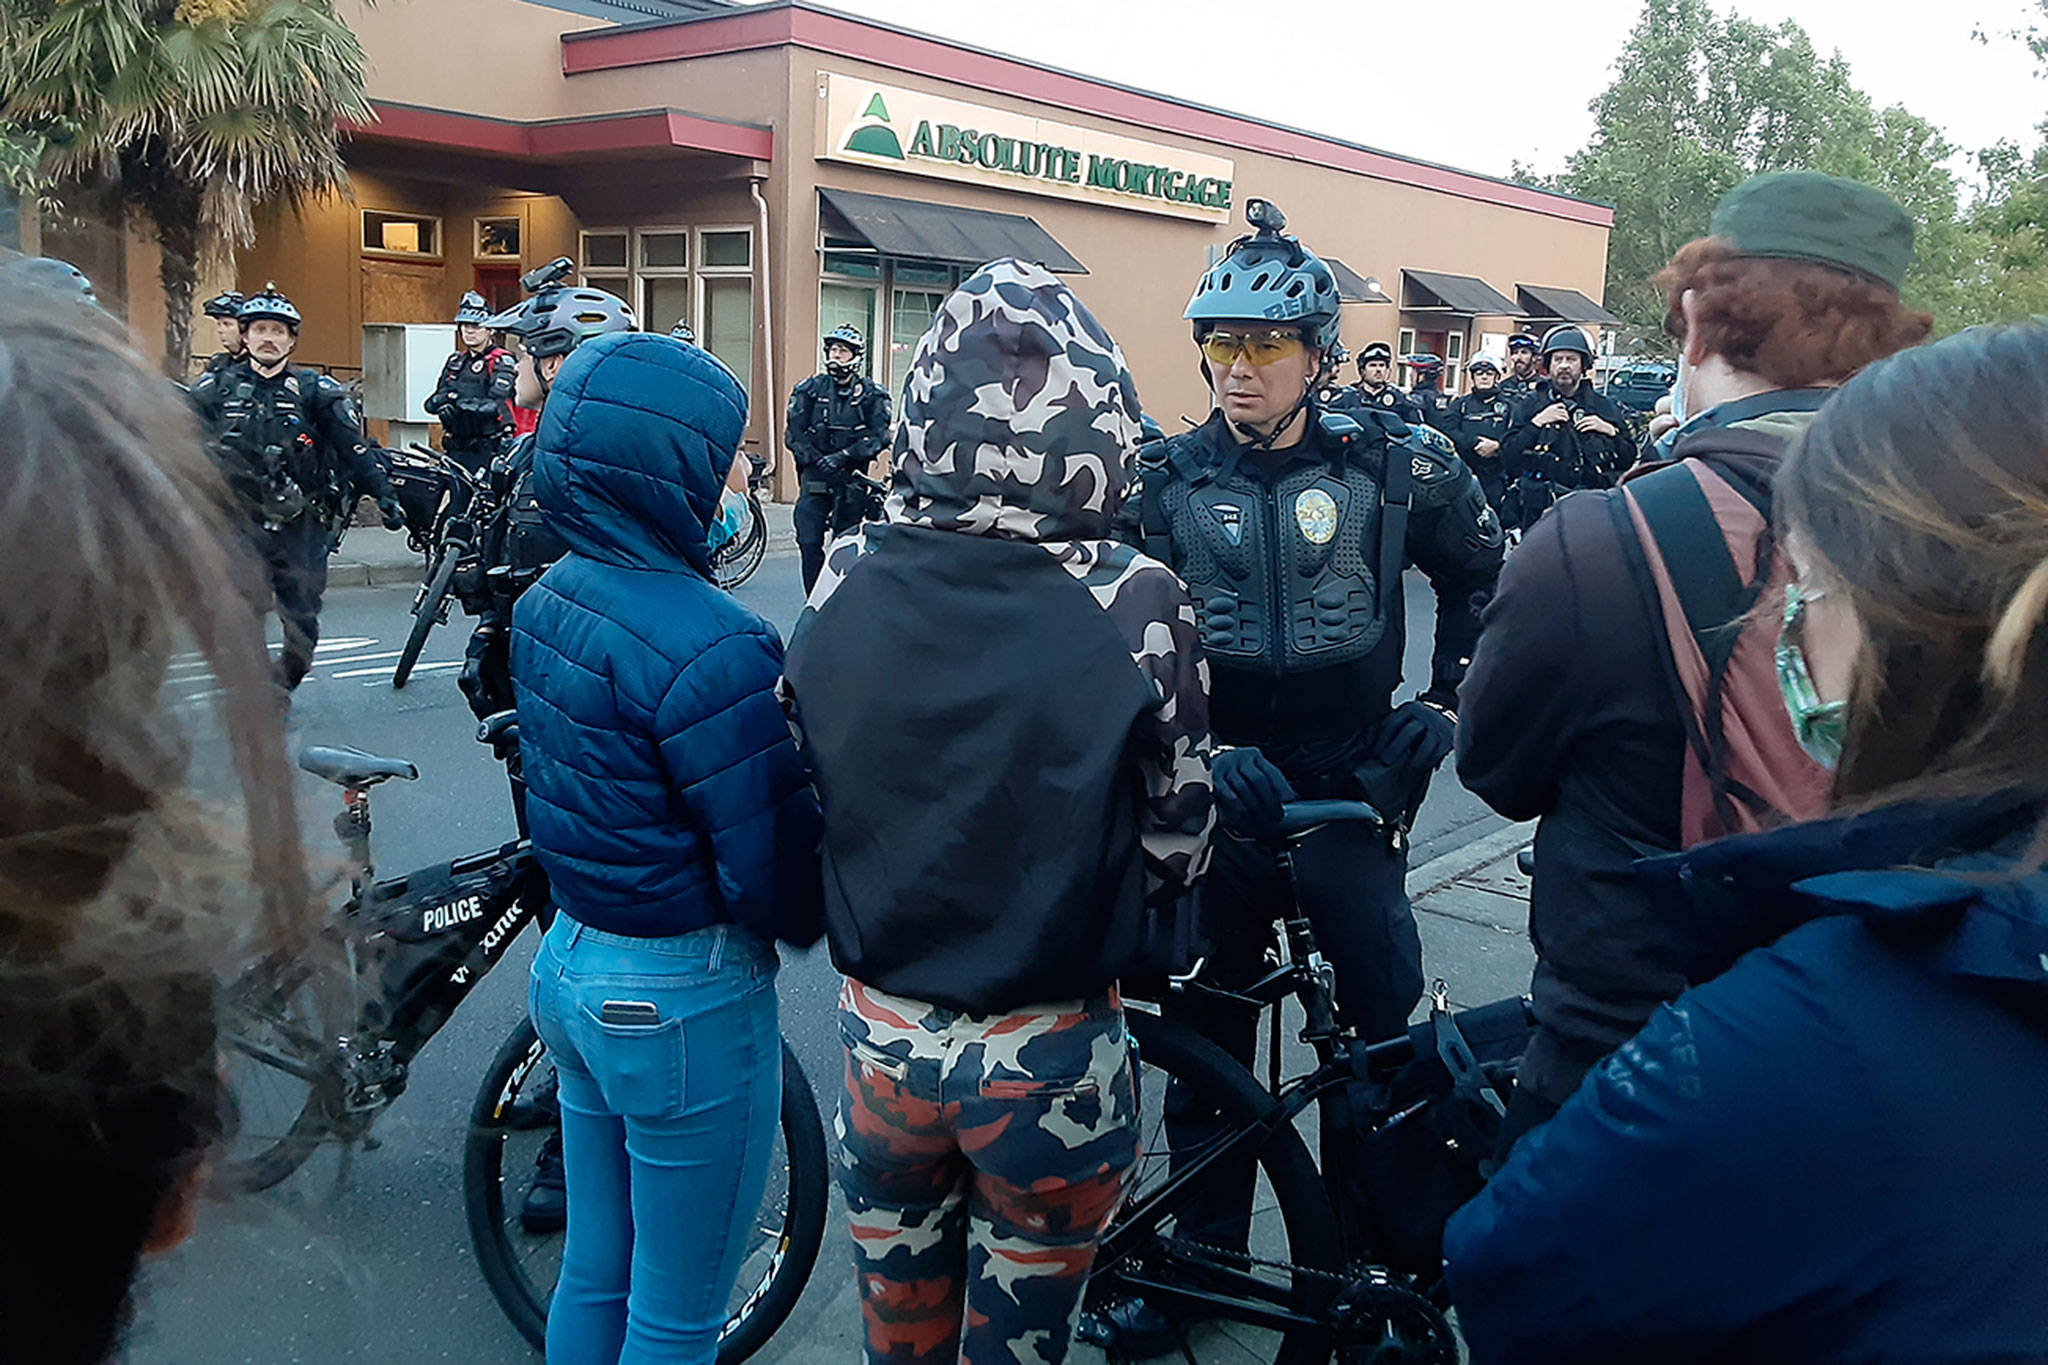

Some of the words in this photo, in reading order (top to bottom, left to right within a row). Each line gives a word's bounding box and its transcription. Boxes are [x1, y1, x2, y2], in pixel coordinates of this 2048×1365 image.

[907, 120, 1081, 183] ABSOLUTE
[1086, 154, 1232, 209] MORTGAGE
[423, 895, 483, 933] POLICE
